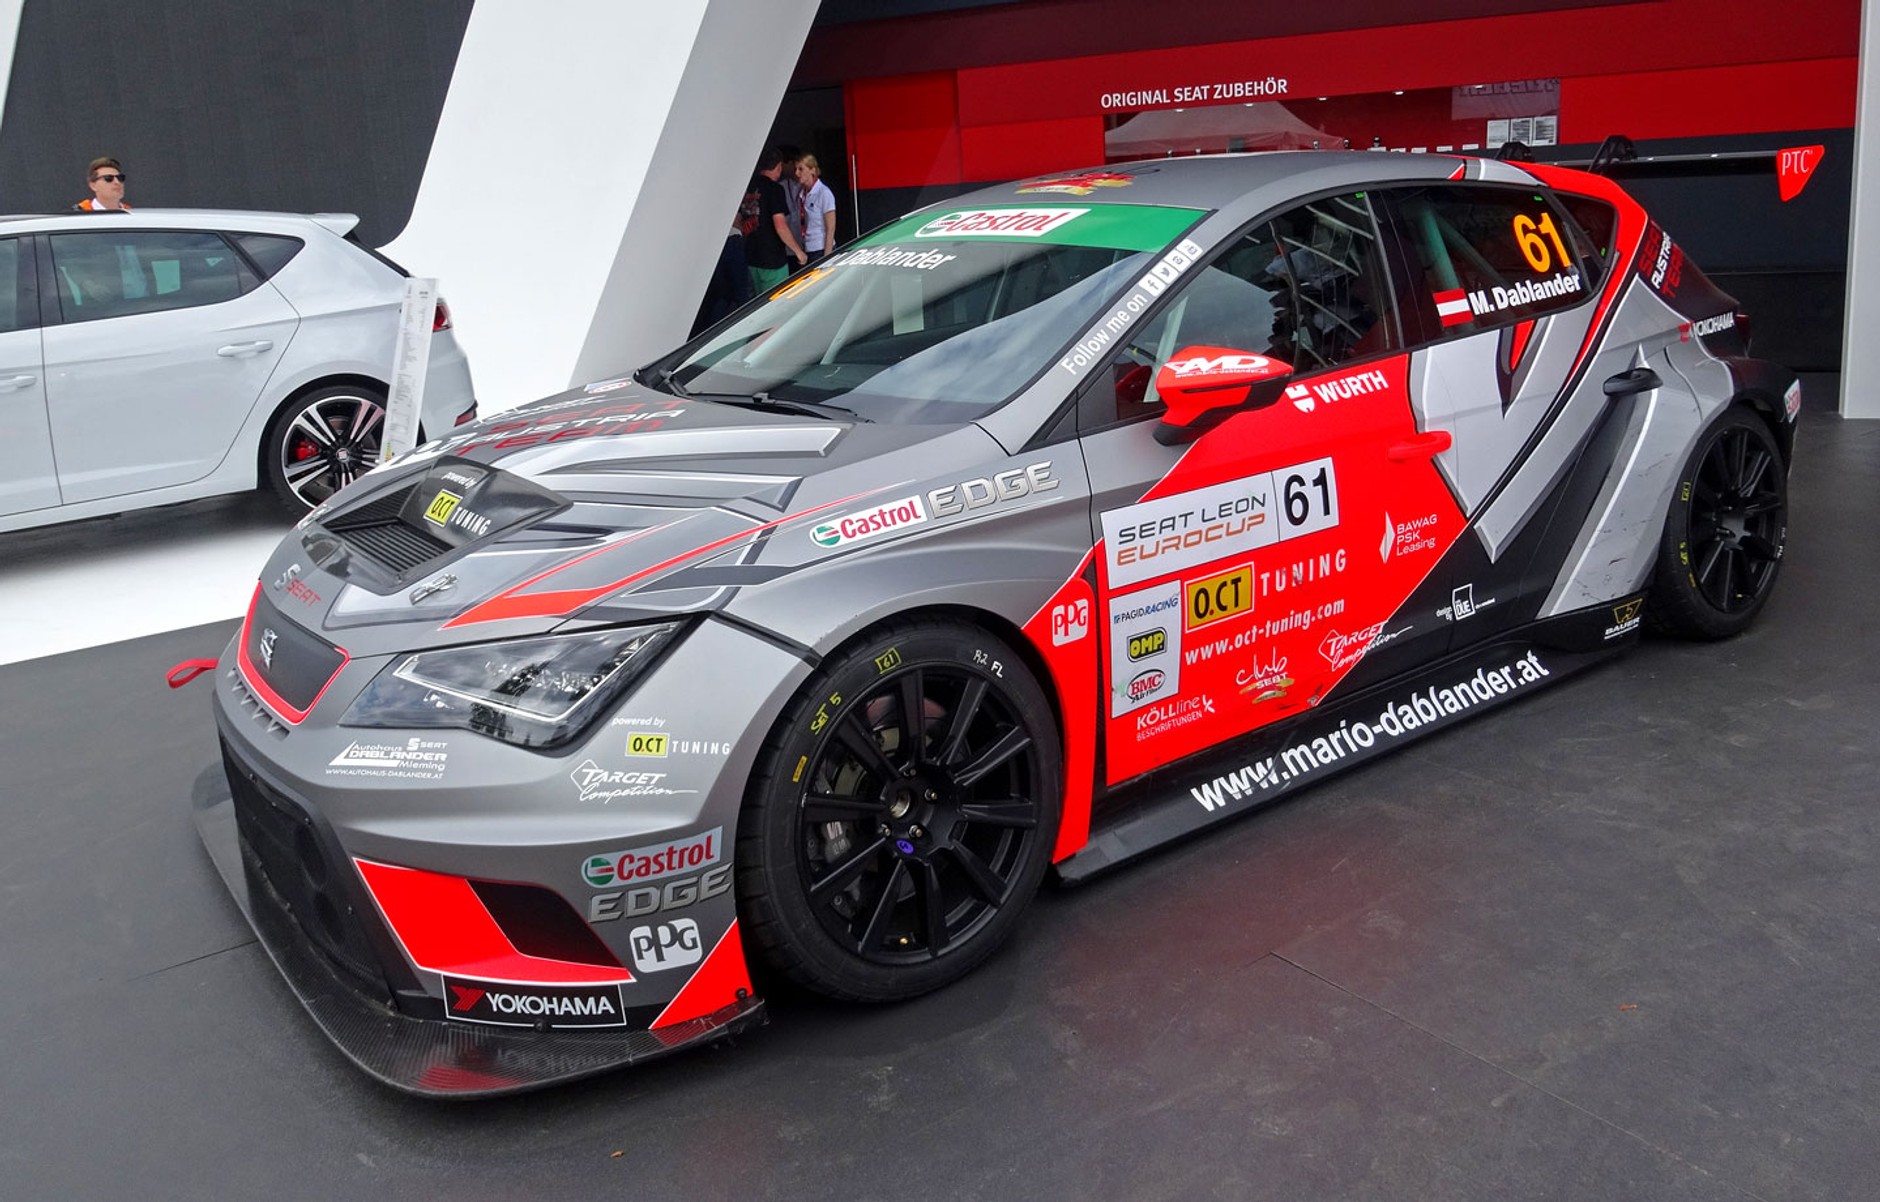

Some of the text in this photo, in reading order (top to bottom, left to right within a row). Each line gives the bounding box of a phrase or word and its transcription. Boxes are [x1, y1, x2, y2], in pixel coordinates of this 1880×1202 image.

[1101, 77, 1288, 108] ORIGINAL SEAT ZUBEHÖR
[946, 212, 1071, 232] Castrol
[1513, 212, 1572, 273] 61
[836, 247, 956, 270] Dablander
[1468, 273, 1581, 315] M. Dablander
[1061, 293, 1148, 375] Follow me on
[1691, 311, 1736, 338] YOKOHAMA
[1313, 370, 1389, 404] WÜRTH
[840, 461, 1061, 539] Castrol EDGE
[1284, 467, 1331, 526] 61
[451, 507, 491, 535] TUNING
[1118, 493, 1266, 545] SEAT LEON
[1397, 514, 1437, 534] BAWAG
[1117, 513, 1266, 566] EUROCUP
[1396, 537, 1436, 556] Leasing
[1397, 530, 1420, 546] PSK
[1260, 549, 1347, 596] TUNING
[1185, 599, 1345, 665] www.oct-tuning.com
[1327, 620, 1388, 656] TARGET
[1332, 627, 1411, 672] Competition
[1236, 646, 1288, 685] club
[1256, 672, 1288, 690] SEAT
[1131, 674, 1162, 695] BMC
[611, 717, 666, 727] powered by
[1136, 711, 1203, 742] BESCHRIFTUNGEN
[1190, 650, 1549, 812] www.mario-dablander.at
[349, 750, 447, 761] DABLANDER
[352, 744, 402, 752] Autohaus
[672, 741, 730, 755] TUNING
[398, 761, 445, 771] Mieming
[582, 768, 667, 786] TARGET
[580, 783, 694, 804] Competition
[617, 834, 715, 880] Castrol
[588, 863, 732, 922] EDGE
[486, 992, 615, 1015] YOKOHAMA
